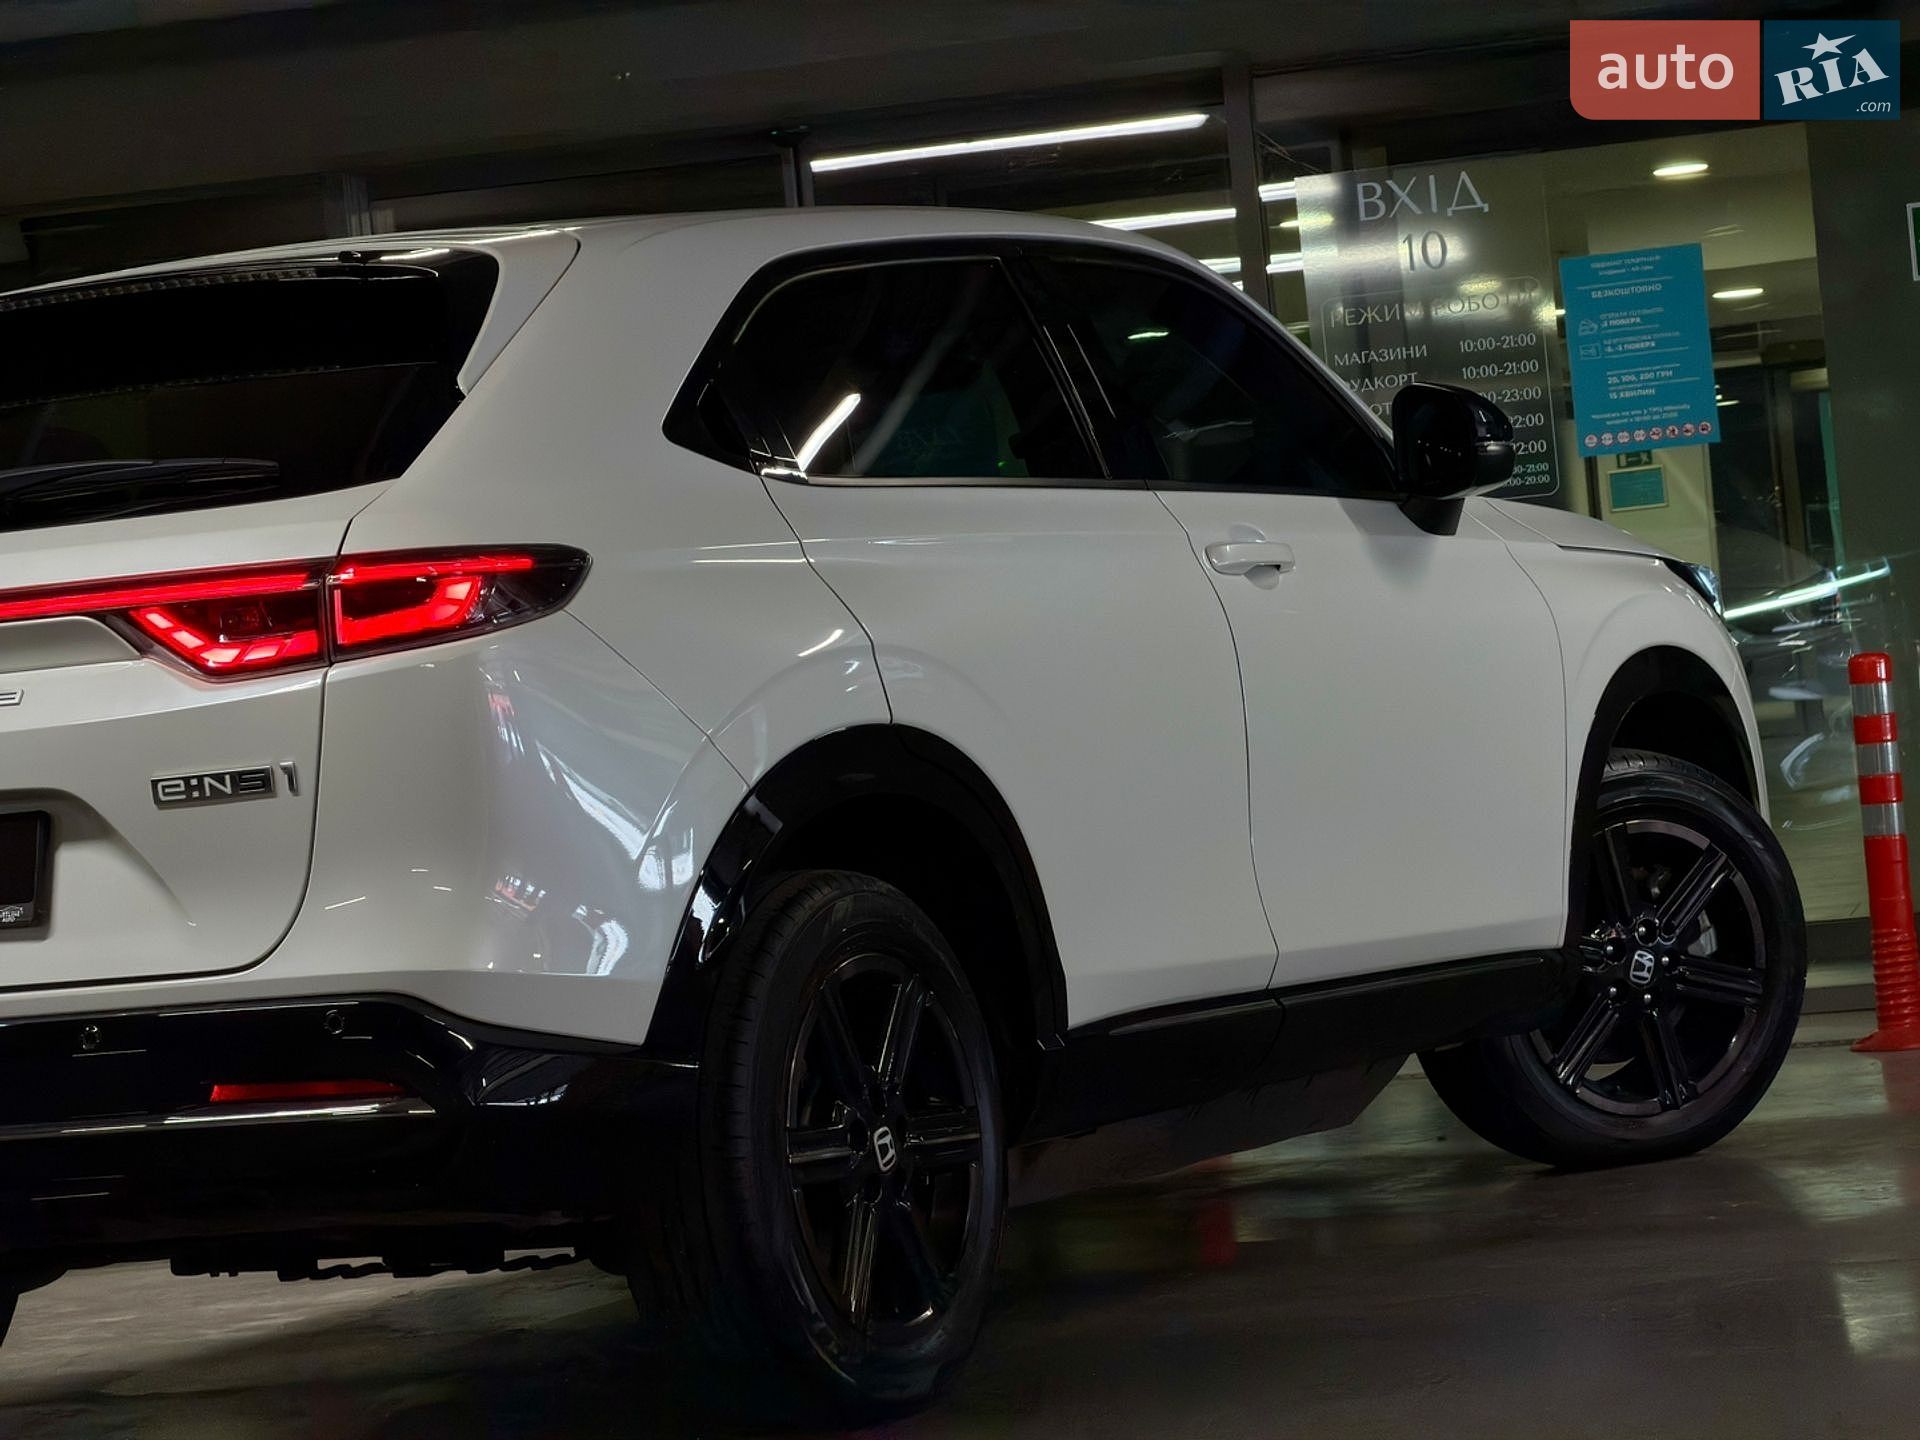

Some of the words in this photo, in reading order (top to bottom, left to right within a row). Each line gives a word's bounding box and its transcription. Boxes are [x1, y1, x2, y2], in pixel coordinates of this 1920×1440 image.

[1356, 170, 1489, 221] ВХІД
[1402, 230, 1448, 272] 10
[1334, 344, 1428, 367] МАГАЗИНИ
[1459, 332, 1536, 353] 10:00-21:00
[1347, 371, 1419, 393] УДКОРТ
[1462, 359, 1539, 380] 10:00-21:00
